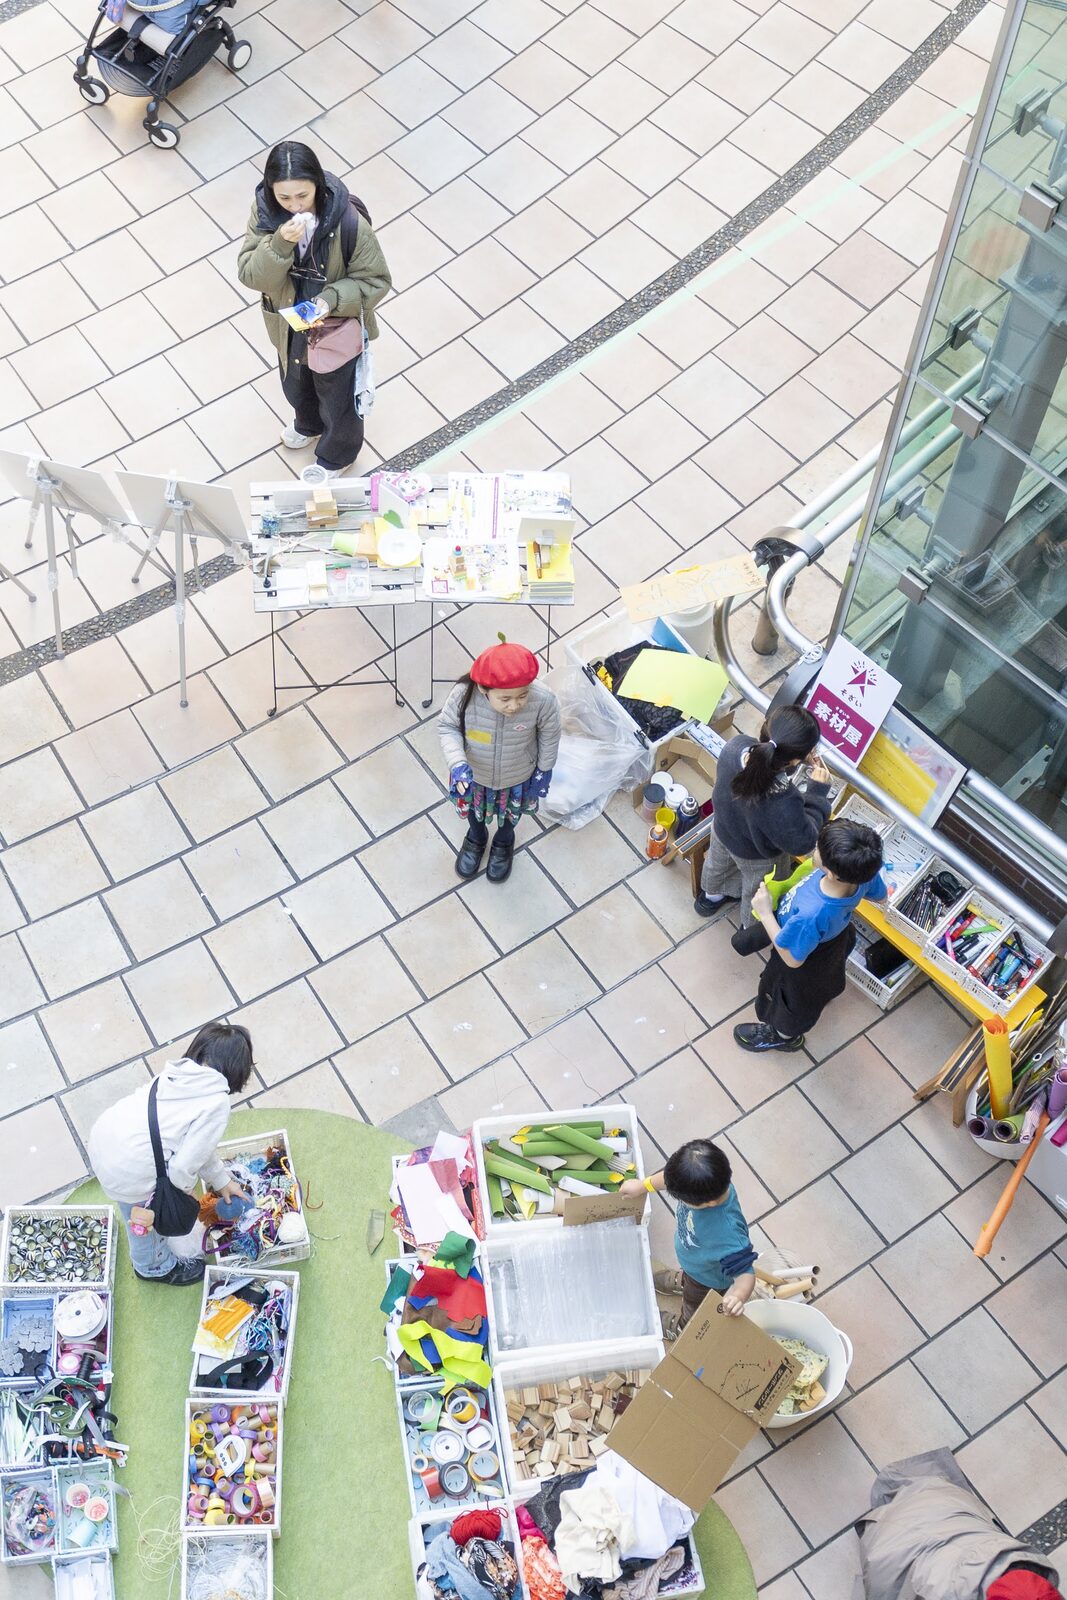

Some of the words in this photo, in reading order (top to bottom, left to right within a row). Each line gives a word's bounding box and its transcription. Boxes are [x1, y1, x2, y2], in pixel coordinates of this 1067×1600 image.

[841, 688, 862, 707] そざい
[813, 700, 863, 747] 素材屋
